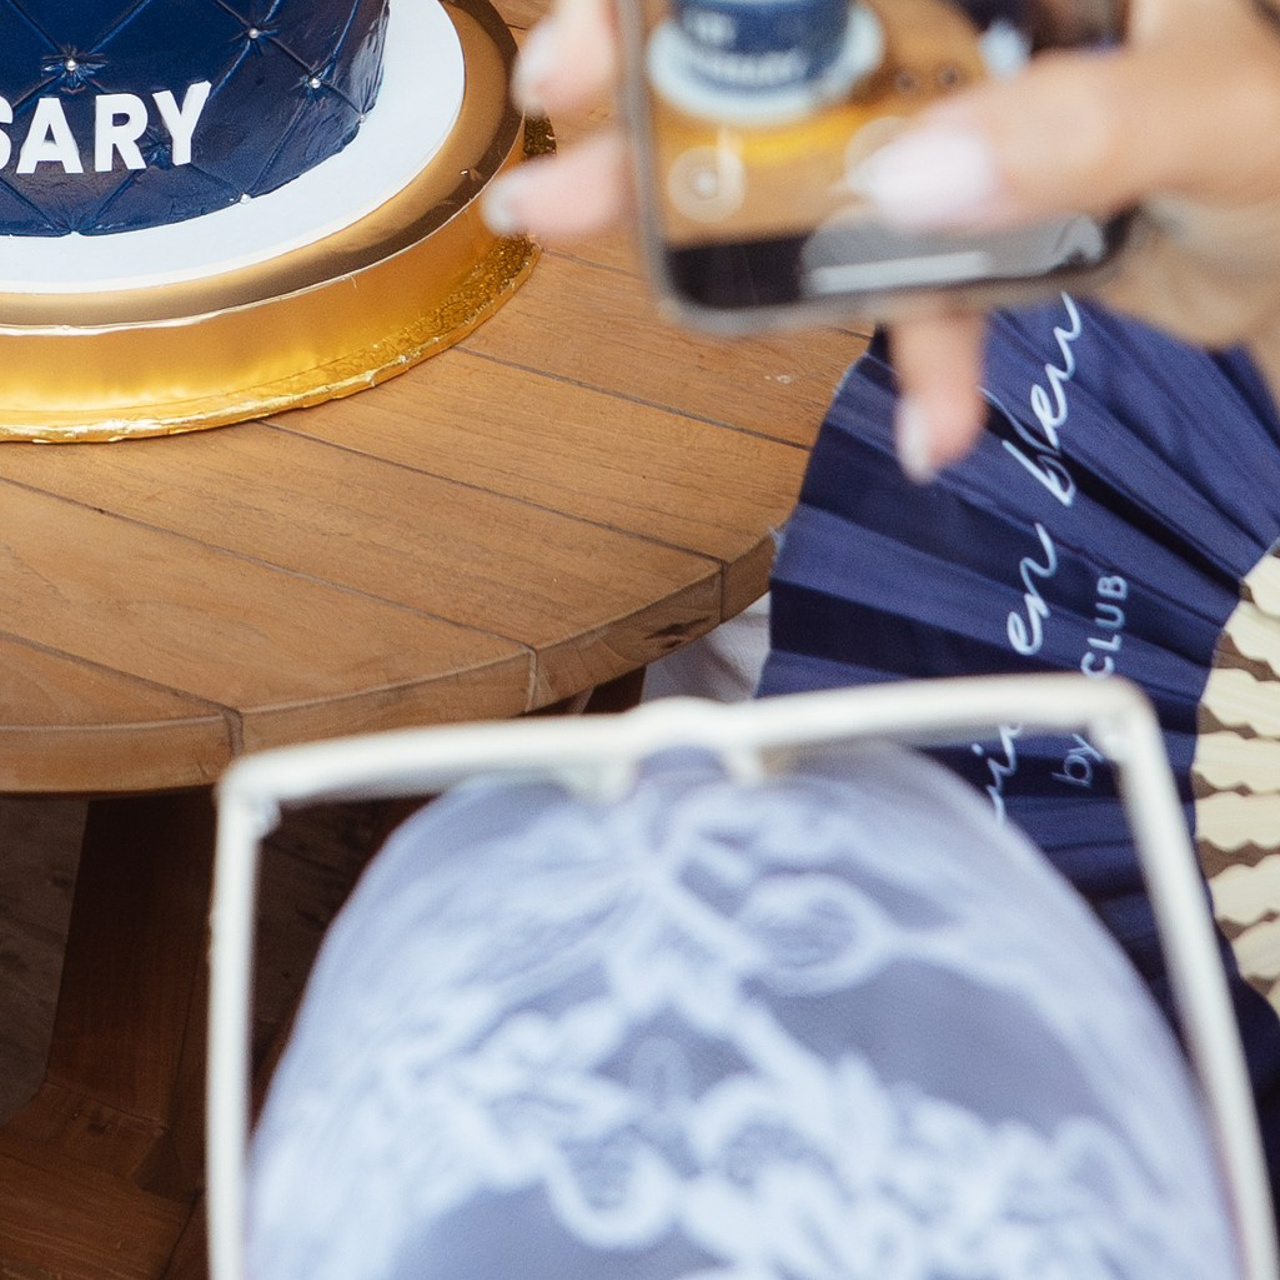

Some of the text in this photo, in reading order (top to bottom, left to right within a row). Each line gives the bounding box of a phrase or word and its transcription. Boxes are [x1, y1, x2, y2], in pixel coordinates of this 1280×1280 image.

[1006, 522, 1058, 656] en
[1051, 575, 1129, 788] by CLUB
